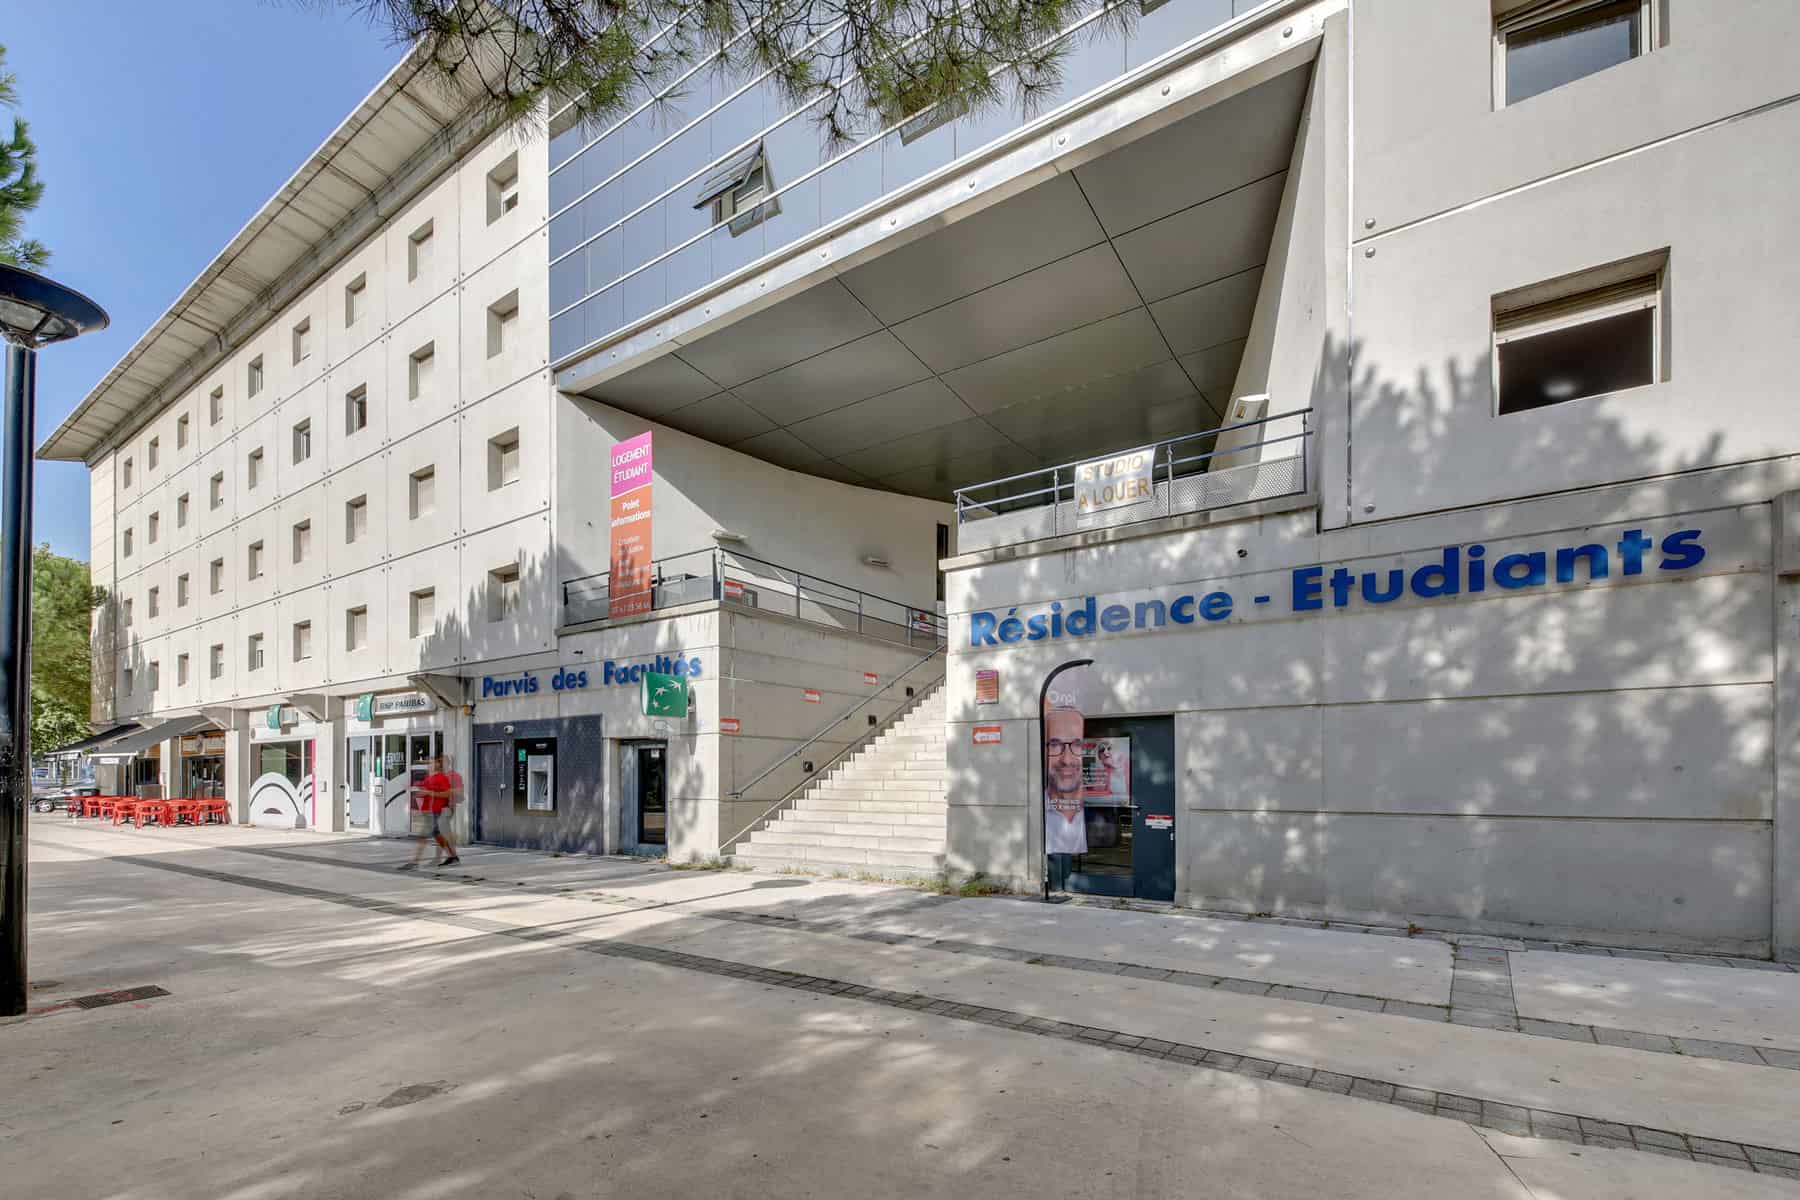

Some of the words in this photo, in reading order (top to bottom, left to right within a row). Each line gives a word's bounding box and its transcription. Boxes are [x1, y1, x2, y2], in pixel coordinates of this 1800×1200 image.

[612, 445, 649, 468] LOGEMENT
[1084, 455, 1143, 480] STUDIO
[1094, 477, 1150, 506] LOUER
[622, 499, 640, 512] Point
[970, 591, 1233, 647] Résidence
[1254, 595, 1270, 604] -
[1292, 529, 1706, 612] Etudiants
[482, 672, 538, 698] Parvis
[552, 667, 588, 690] des
